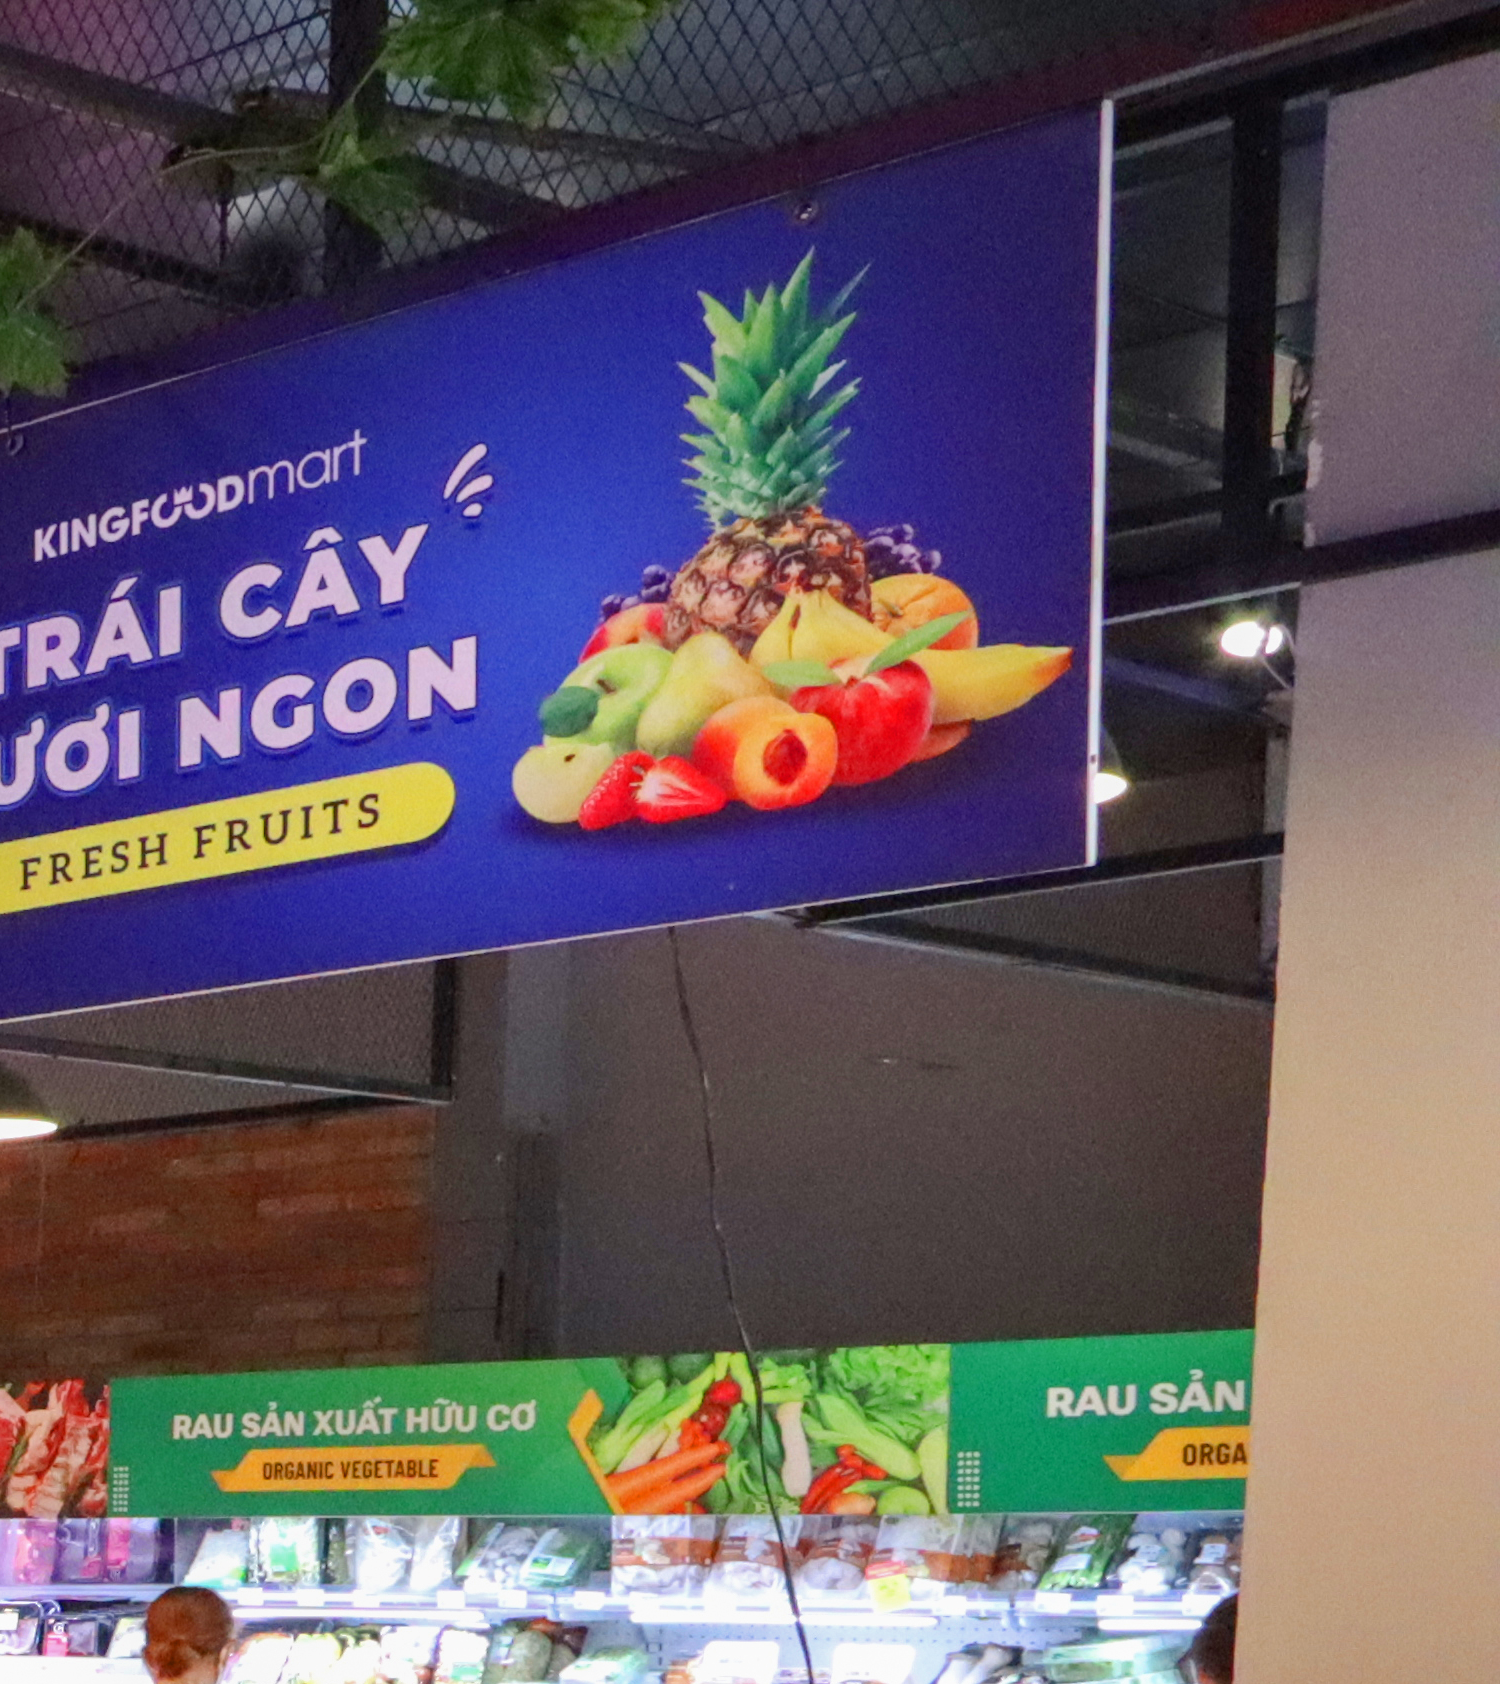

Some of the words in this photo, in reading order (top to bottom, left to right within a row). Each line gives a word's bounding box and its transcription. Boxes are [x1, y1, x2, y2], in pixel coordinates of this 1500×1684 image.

[33, 429, 366, 562] KINGFOODmart
[219, 525, 429, 641] CÂY
[178, 635, 477, 768] NGON
[20, 833, 169, 890] FRESH
[193, 793, 381, 860] FRUITS
[172, 1413, 235, 1440] RAU
[241, 1401, 305, 1439] SẢN
[313, 1396, 398, 1436] XUẤT
[405, 1397, 478, 1434] HỮU
[486, 1399, 538, 1432] CƠ
[1046, 1384, 1137, 1418] RAU
[1149, 1368, 1246, 1415] SẢN
[262, 1460, 334, 1481] ORGANIC
[341, 1458, 440, 1480] VEGETABLE
